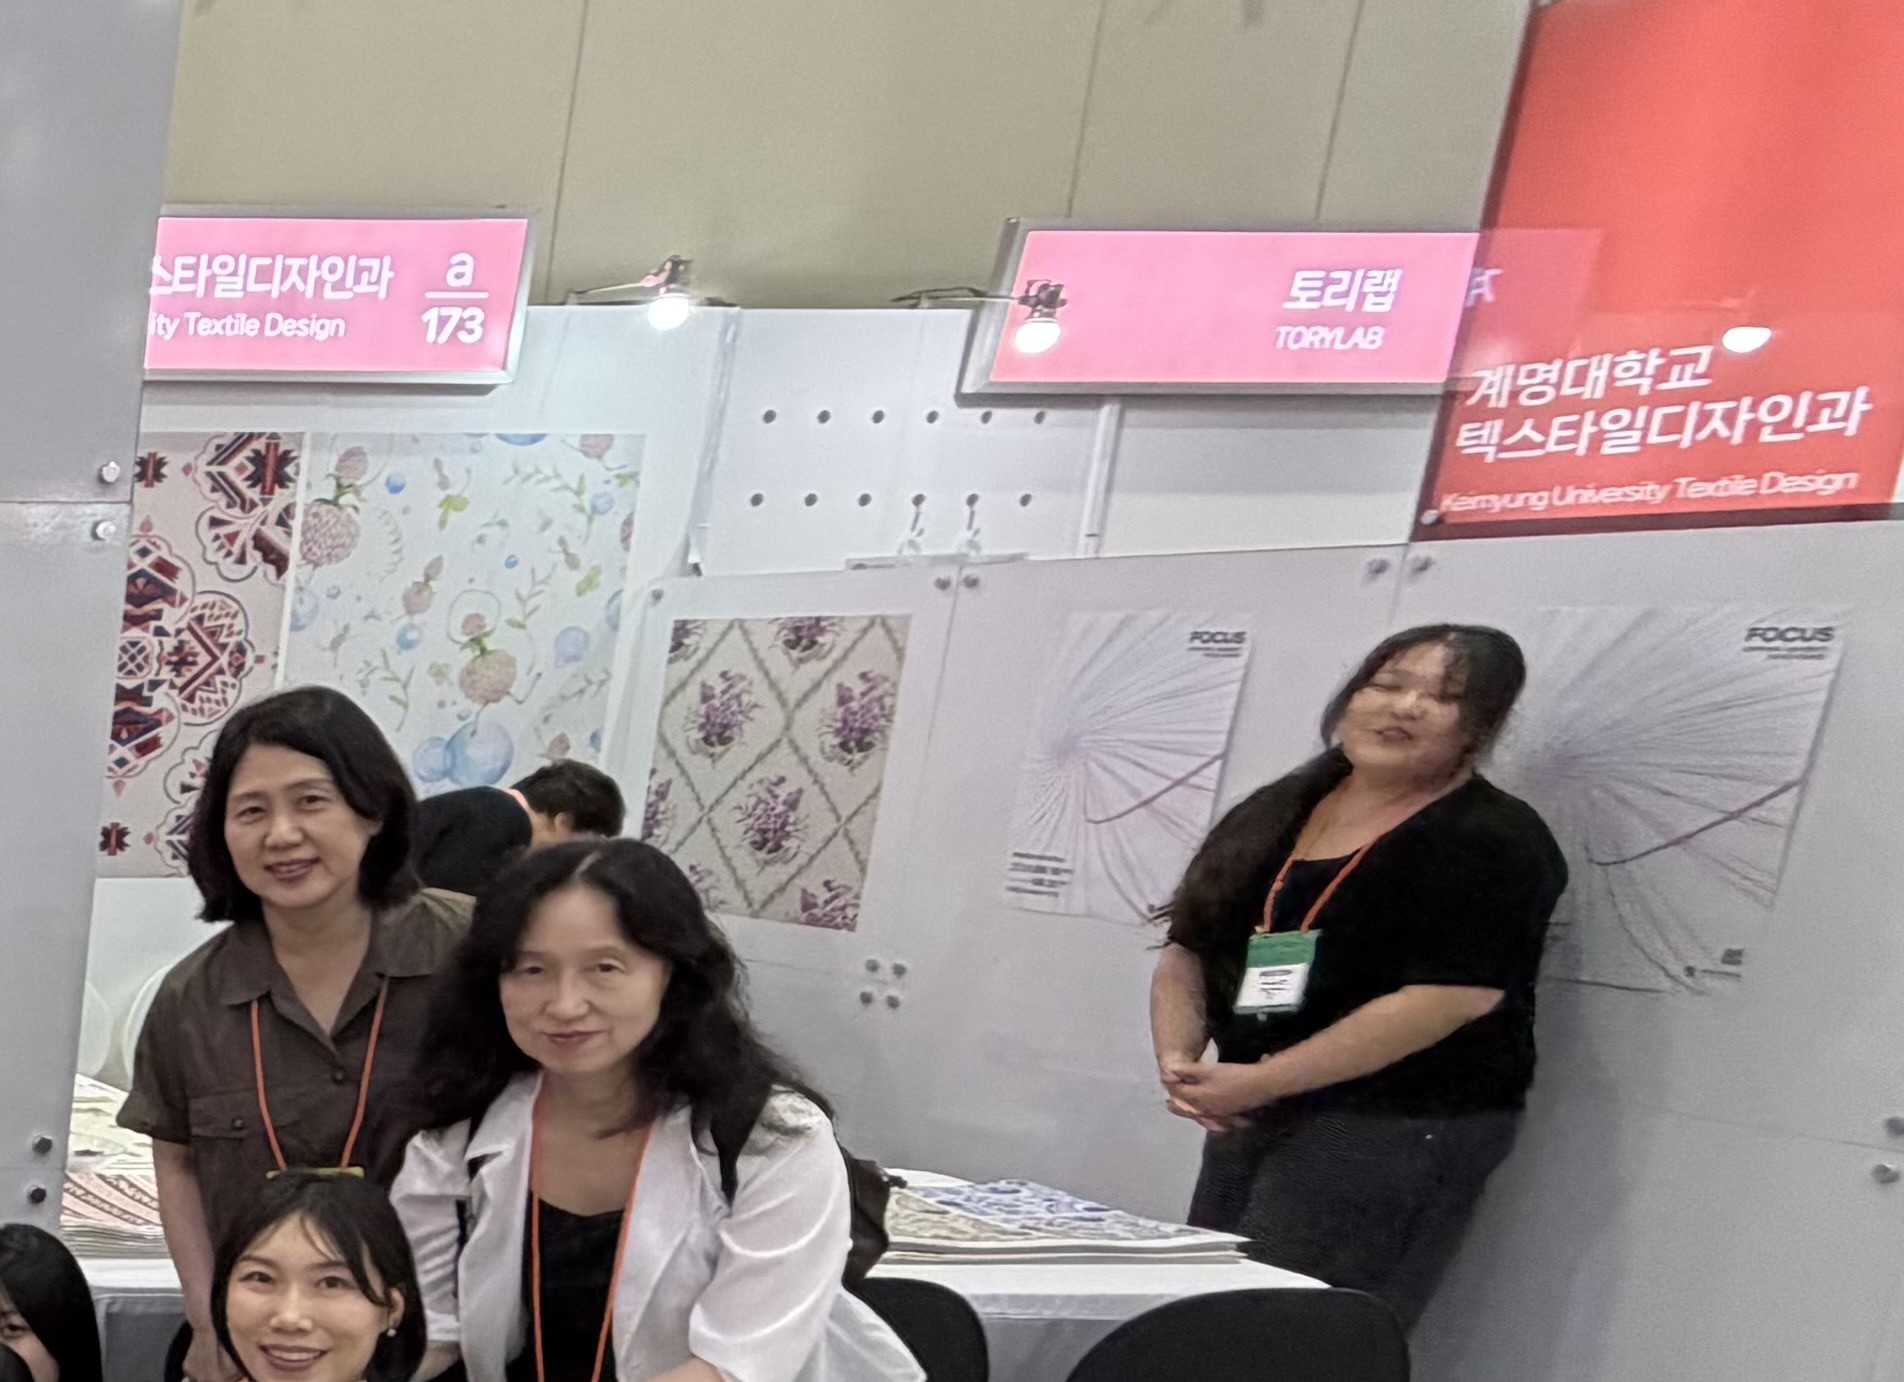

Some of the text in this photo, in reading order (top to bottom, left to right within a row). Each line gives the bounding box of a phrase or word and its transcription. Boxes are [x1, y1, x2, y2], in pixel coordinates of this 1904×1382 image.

[445, 252, 476, 288] a
[1281, 268, 1404, 313] 토리랩
[184, 311, 260, 338] Textile
[264, 313, 346, 341] Design
[421, 306, 486, 345] 173
[1274, 324, 1386, 351] TORYLAB
[1464, 344, 1714, 410] 계명대학교
[1455, 385, 1873, 464] 텍스타일디자인과
[1552, 480, 1675, 507] University
[1759, 468, 1860, 498] Design
[1188, 630, 1248, 645] FOCUS
[1743, 626, 1835, 643] FOCUS
